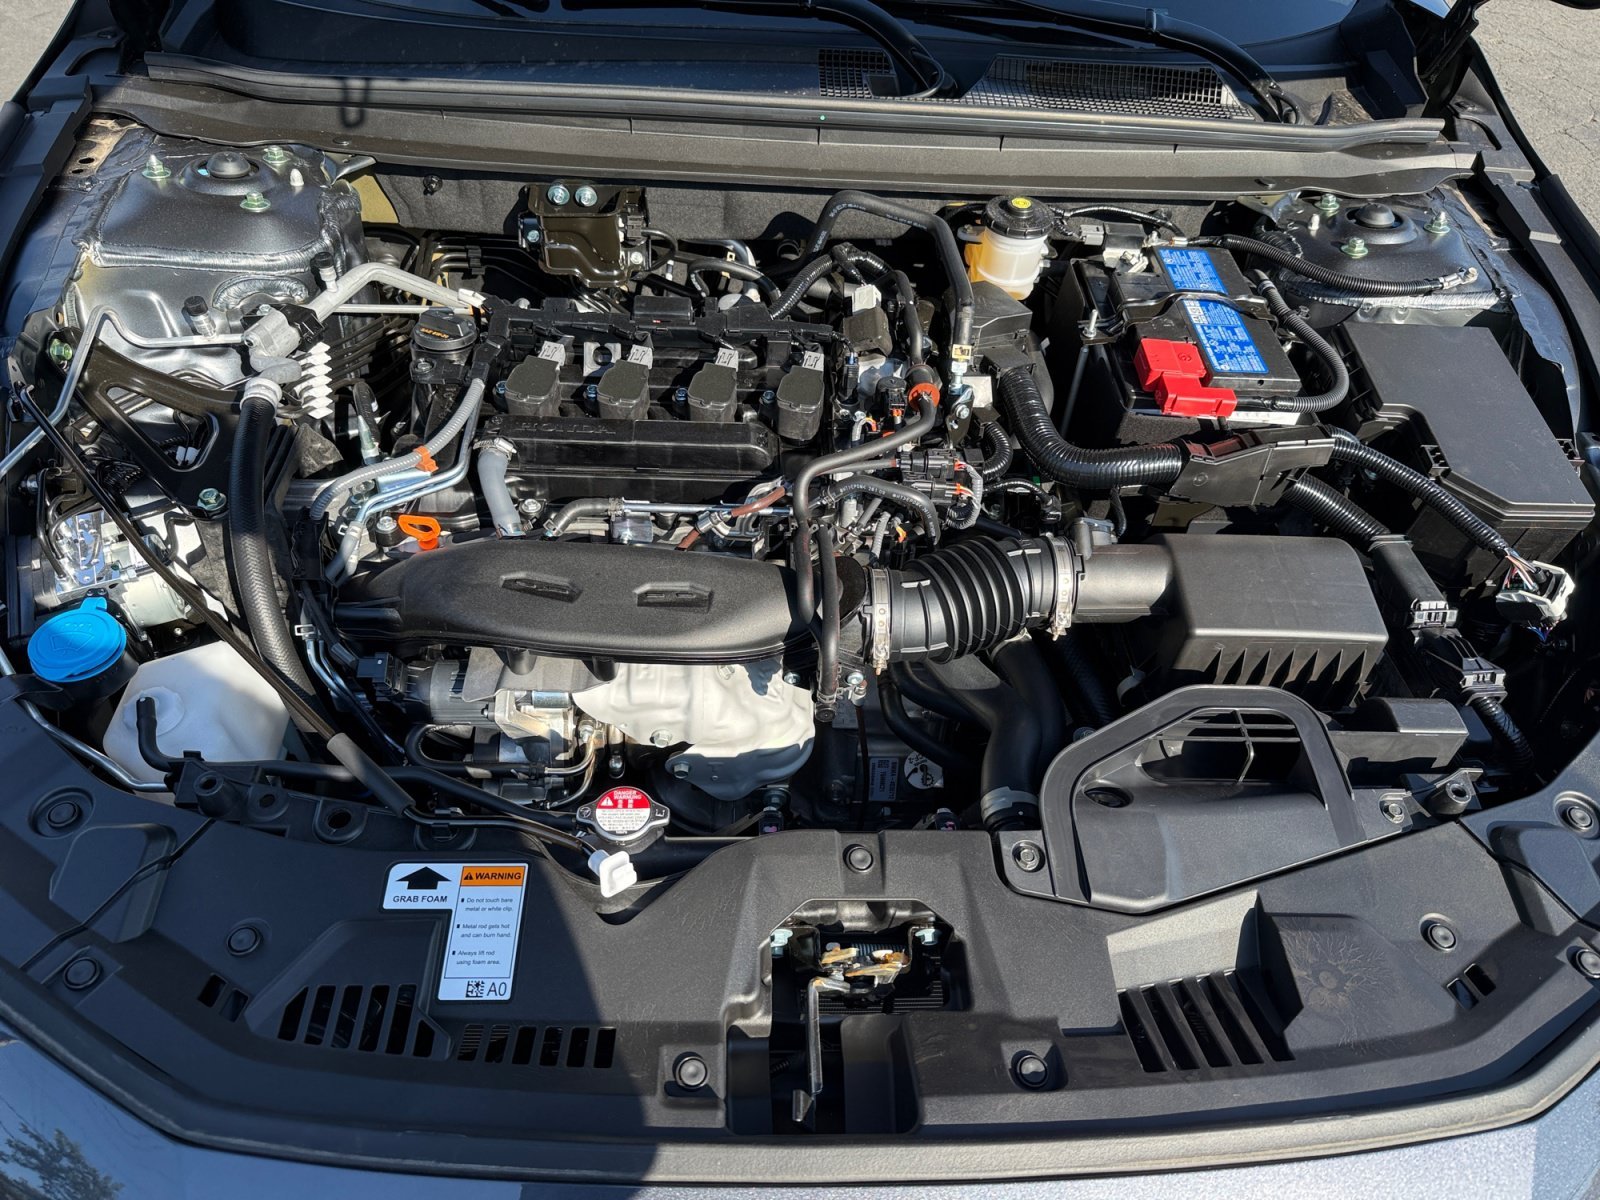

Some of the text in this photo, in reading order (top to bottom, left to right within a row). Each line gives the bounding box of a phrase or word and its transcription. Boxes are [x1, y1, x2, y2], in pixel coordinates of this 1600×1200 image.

[514, 421, 617, 435] HONDA
[475, 872, 522, 880] WARNING
[392, 895, 448, 903] GRAB FOAM
[486, 981, 507, 997] A0
